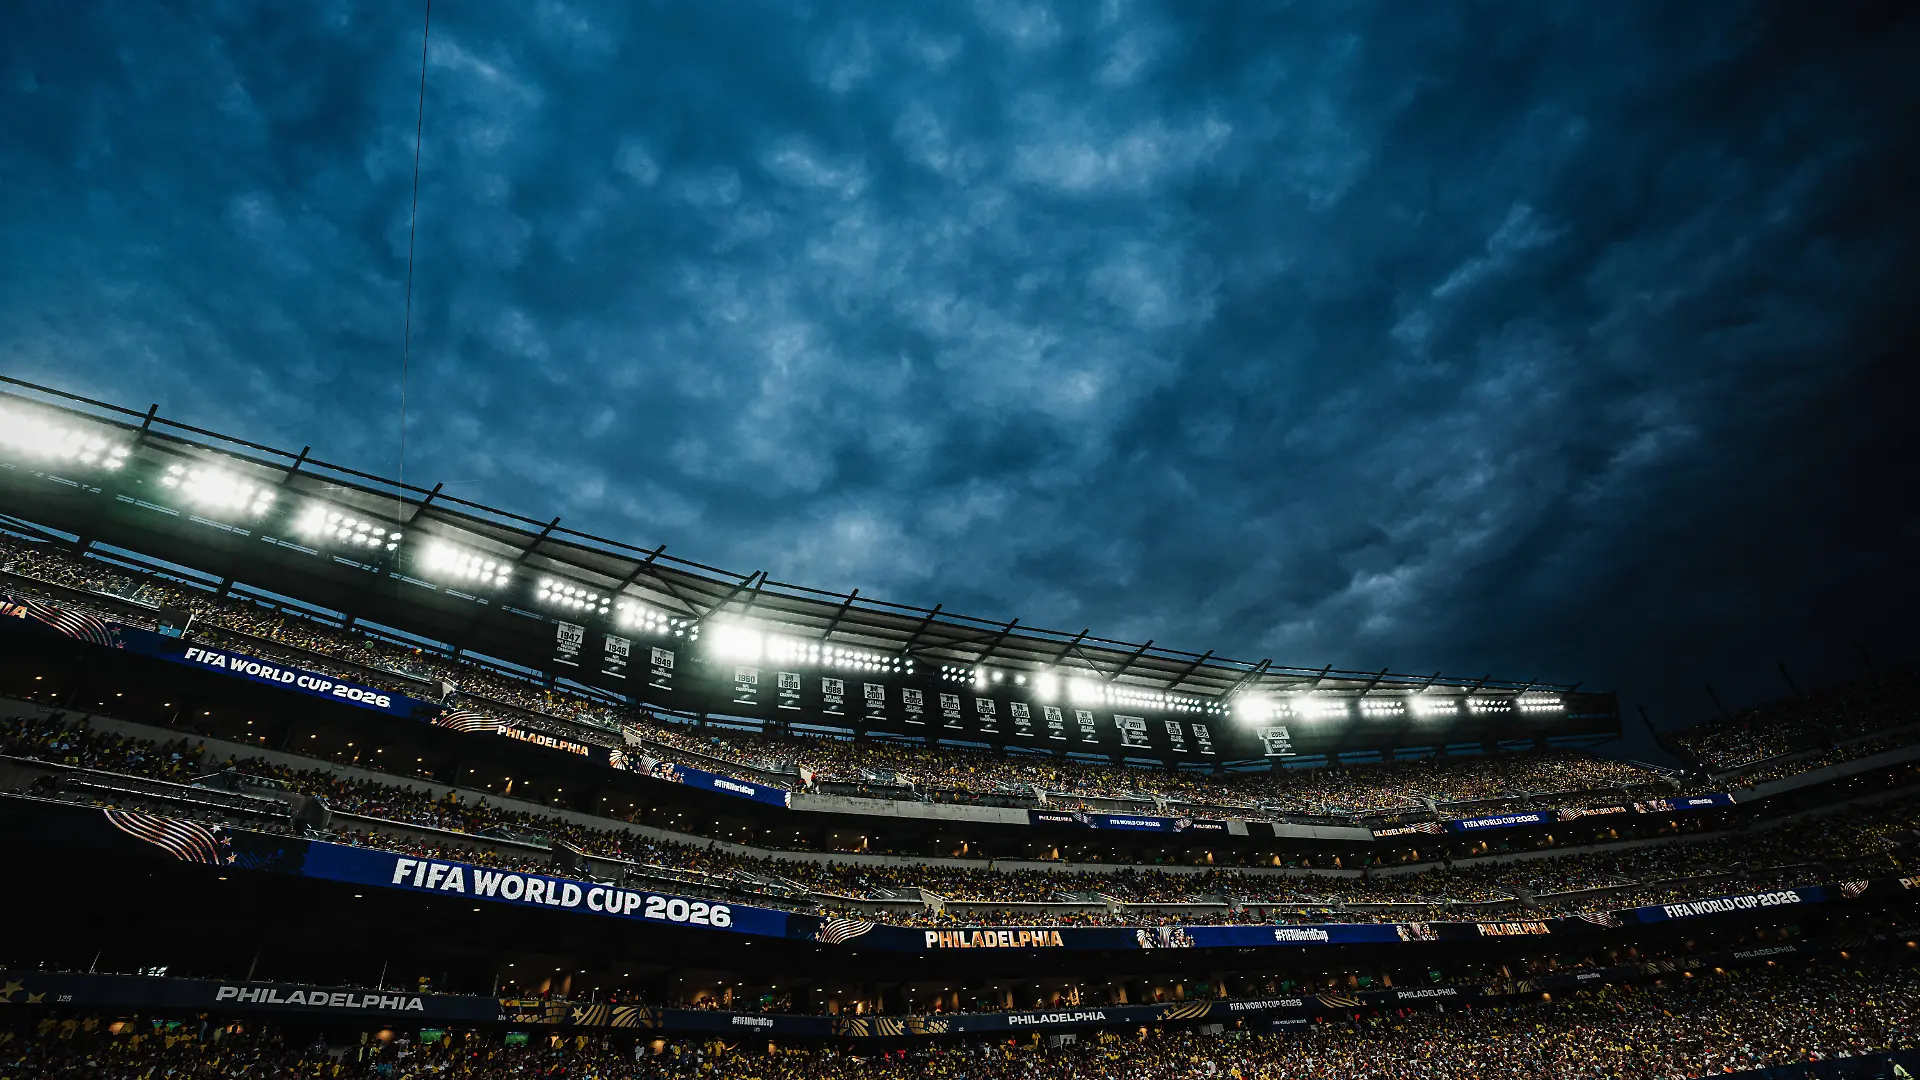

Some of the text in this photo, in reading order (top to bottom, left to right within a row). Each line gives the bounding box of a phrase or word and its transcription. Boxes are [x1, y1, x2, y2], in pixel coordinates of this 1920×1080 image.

[560, 630, 580, 641] 1947
[608, 643, 627, 655] 1948
[654, 656, 672, 667] 1949
[184, 647, 390, 708] FIFA WORLD CUP 2026
[738, 674, 755, 683] 1960
[781, 680, 798, 689] 1980
[866, 692, 883, 700] 2001
[904, 696, 922, 705] 2002
[943, 701, 959, 710] 2003
[1129, 721, 1141, 729] 2017
[497, 724, 589, 756] PHILADELPHIA
[713, 779, 755, 796] #FIFAWorldCup
[1582, 806, 1627, 817] PHILADELPHIA
[1462, 814, 1540, 829] FIFA WORLD CUP 2026
[392, 858, 731, 928] FIFA WORLD CUP 2026
[1663, 890, 1801, 919] FIFA WORLD CUP 2026
[1274, 927, 1329, 943] #FIFAWorldCup
[1476, 921, 1551, 936] PHILADELPHIA
[925, 930, 1064, 949] PHILADELPHIA
[1733, 945, 1796, 959] PHILADELPHIA
[215, 986, 424, 1012] PHILADELPHIA
[1397, 987, 1457, 1000] PHILADELPHIA
[1229, 998, 1303, 1011] FIFA WORLD CUP 2026
[732, 1016, 774, 1028] #FIFAWorldCup
[1008, 1011, 1106, 1025] PHILADELPHIA
